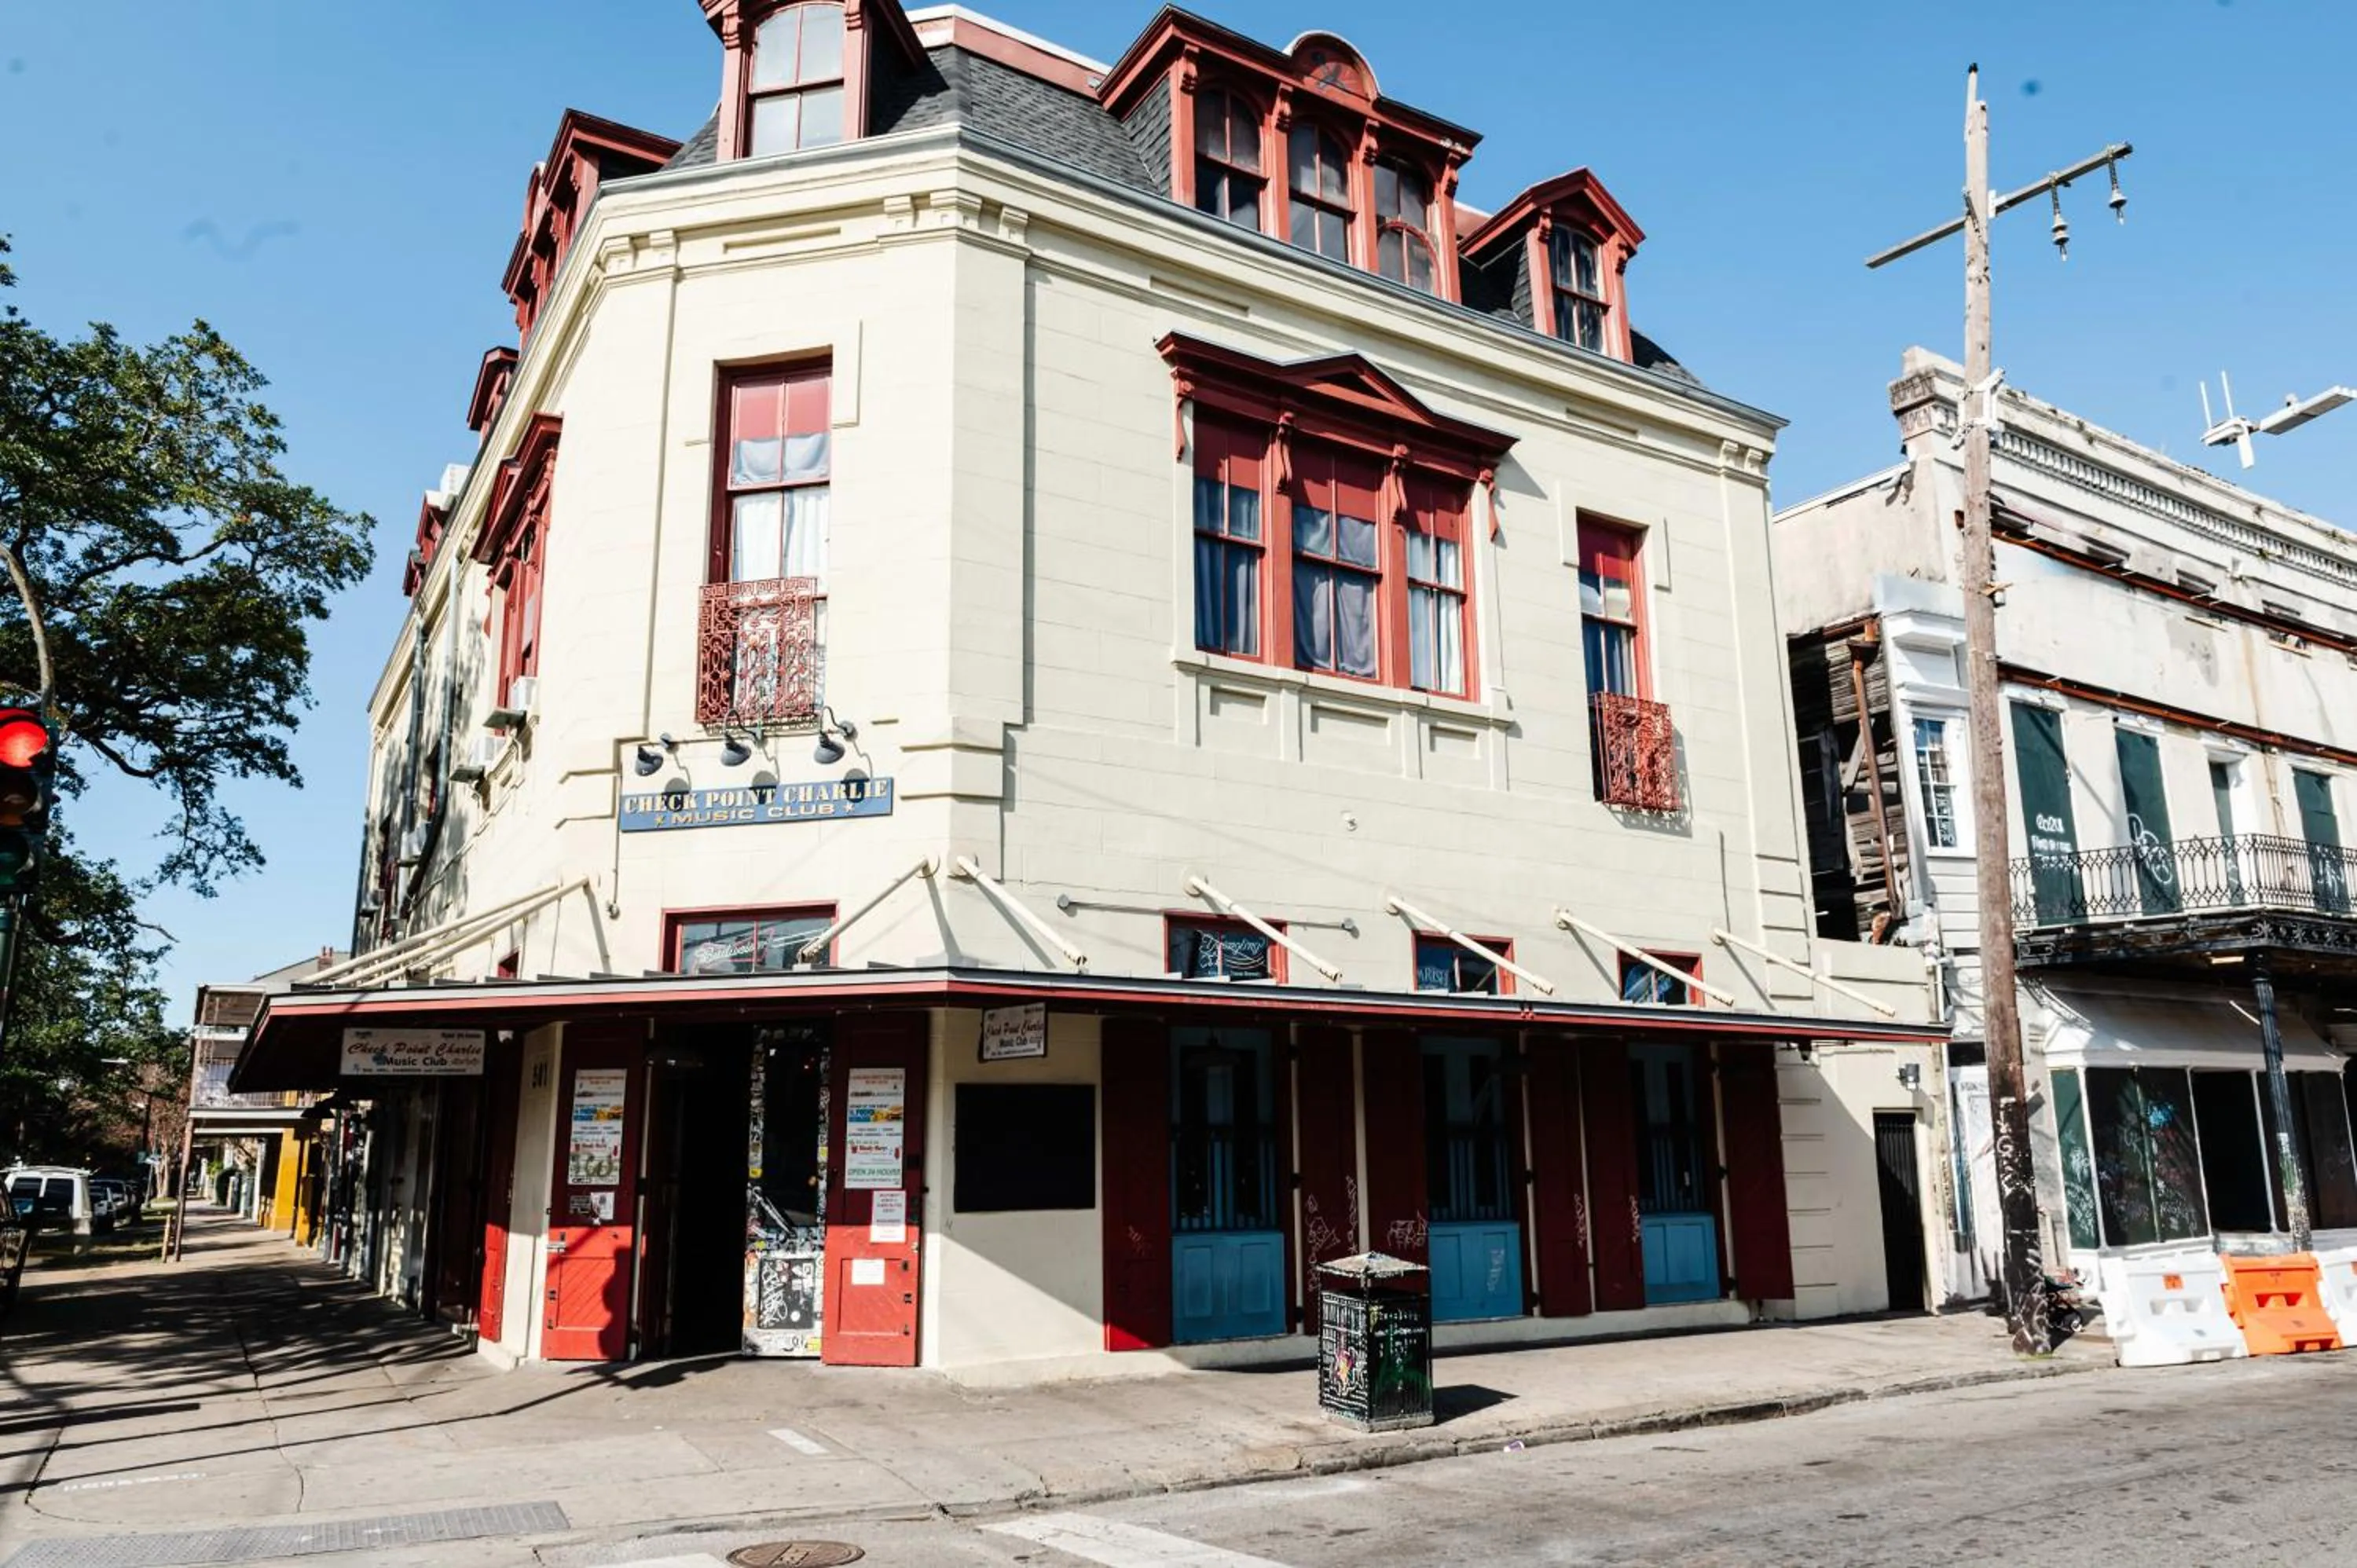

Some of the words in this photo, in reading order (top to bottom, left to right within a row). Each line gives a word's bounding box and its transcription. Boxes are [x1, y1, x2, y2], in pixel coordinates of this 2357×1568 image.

[625, 792, 698, 814] CHECK
[706, 788, 776, 808] POINT
[783, 779, 887, 803] CHARLIE
[671, 808, 755, 824] MUSIC
[767, 804, 835, 818] CLUB
[346, 1042, 389, 1055] Check
[394, 1042, 431, 1055] Point
[434, 1042, 482, 1057] Charlie
[385, 1057, 417, 1066] Music
[422, 1056, 448, 1066] Club
